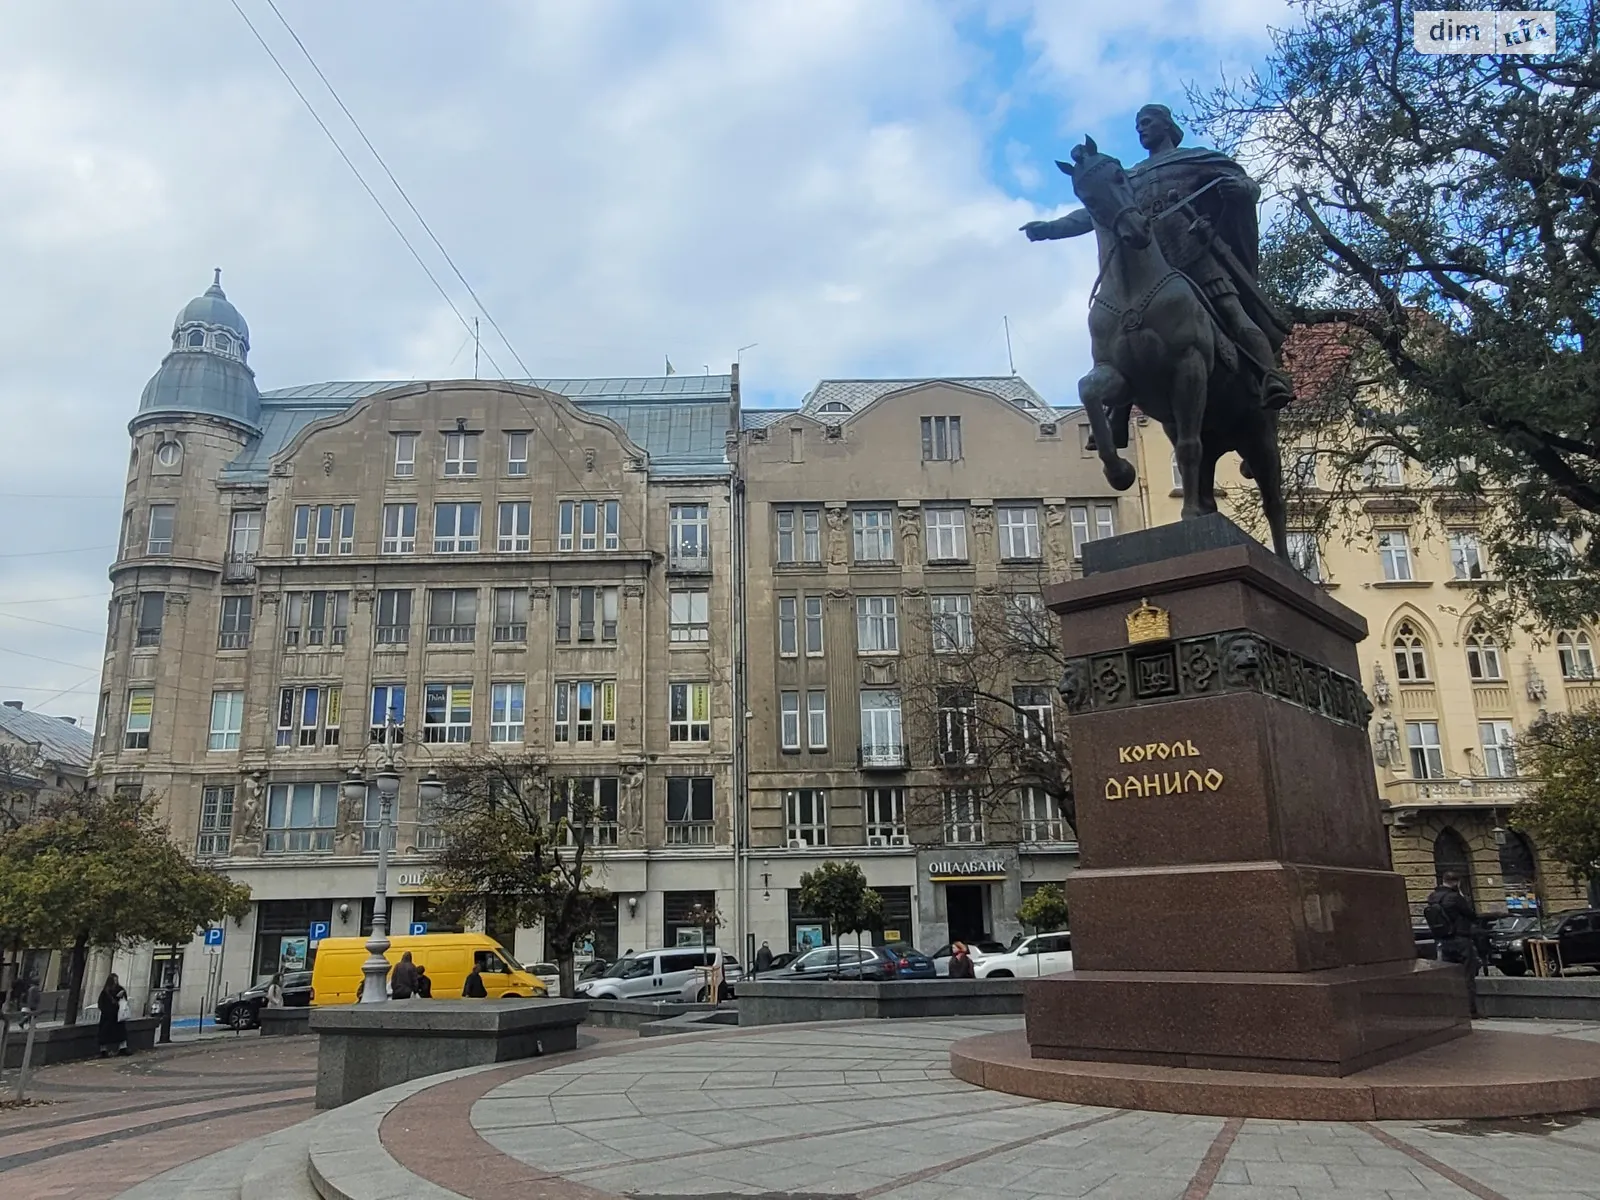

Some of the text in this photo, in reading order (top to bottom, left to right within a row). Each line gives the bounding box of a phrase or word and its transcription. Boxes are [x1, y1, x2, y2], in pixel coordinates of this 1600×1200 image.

[1118, 739, 1200, 763] КОРОЛЬ
[1105, 768, 1224, 800] ДАНИЛО
[928, 860, 1007, 874] ОЩАДБАНК
[209, 929, 221, 944] P
[315, 923, 326, 938] P
[414, 924, 424, 935] P
